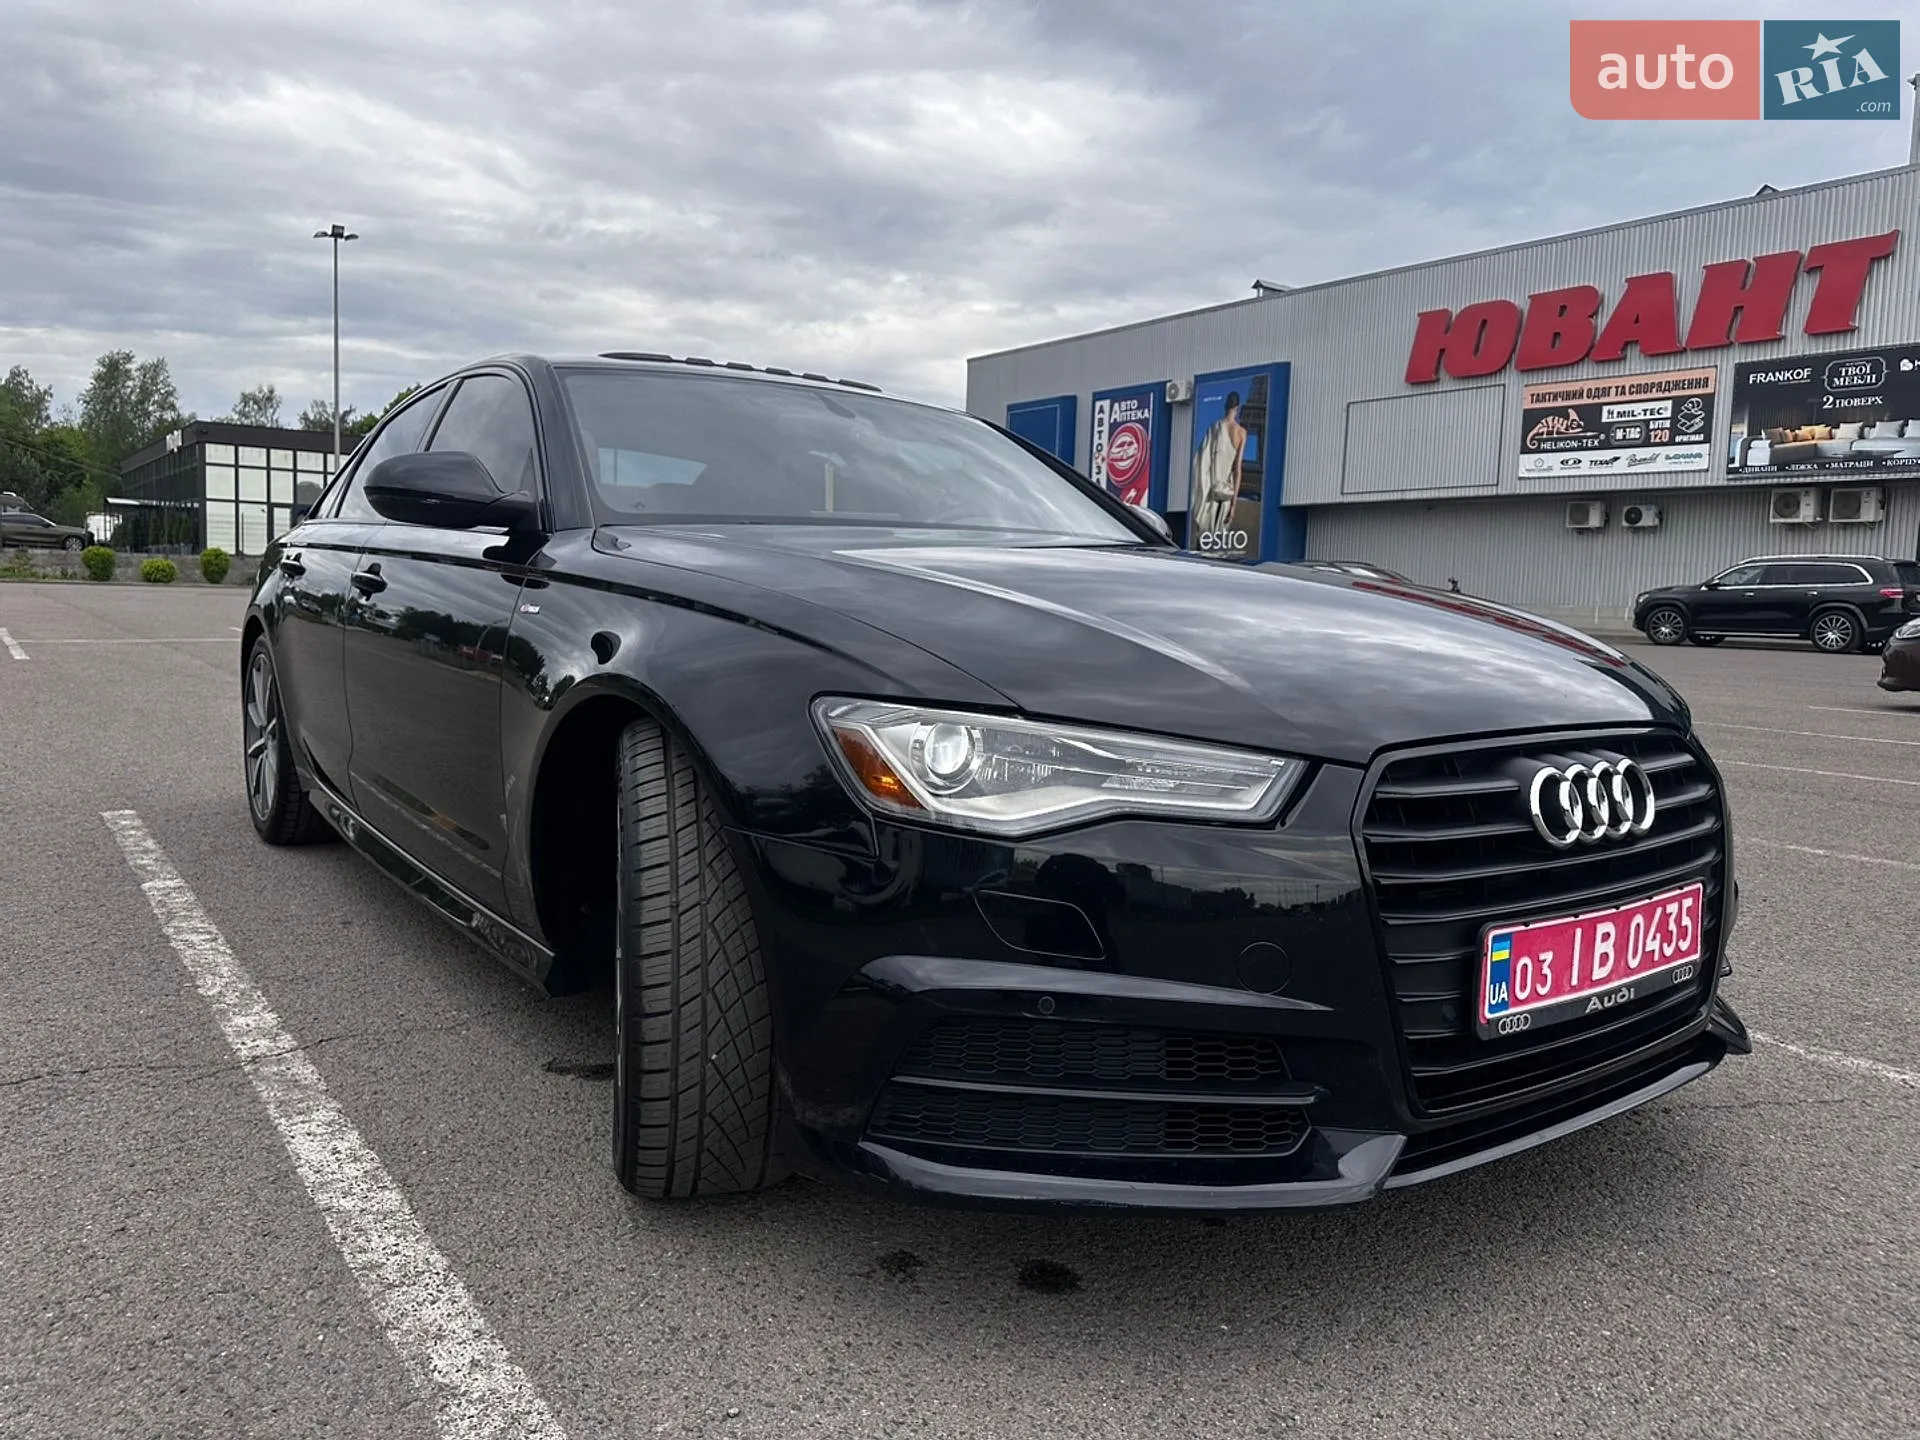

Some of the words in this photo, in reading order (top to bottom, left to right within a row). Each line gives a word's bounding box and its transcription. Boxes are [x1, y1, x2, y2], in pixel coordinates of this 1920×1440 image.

[1405, 229, 1900, 385] ЮВАНТ
[1749, 367, 1812, 385] FRANKOF
[1838, 362, 1872, 376] ТВОЇ
[1833, 374, 1876, 387] МЕБЛІ
[1530, 386, 1584, 404] ТАКТИЧНИЙ
[1586, 385, 1612, 400] ОДЯГ
[1614, 384, 1627, 398] ТА
[1628, 376, 1710, 396] СПОРЯДЖЕННЯ
[1822, 394, 1834, 409] 2
[1835, 395, 1883, 407] ПОВЕРХ
[1616, 407, 1664, 418] MIL-TEC
[1540, 438, 1600, 449] HELIKON-TEX
[1650, 429, 1670, 443] 120
[1200, 529, 1248, 550] estro
[1514, 950, 1554, 1000] 03
[1627, 897, 1693, 970] 0435
[1489, 983, 1508, 1005] UA
[1585, 986, 1635, 1014] Audi
